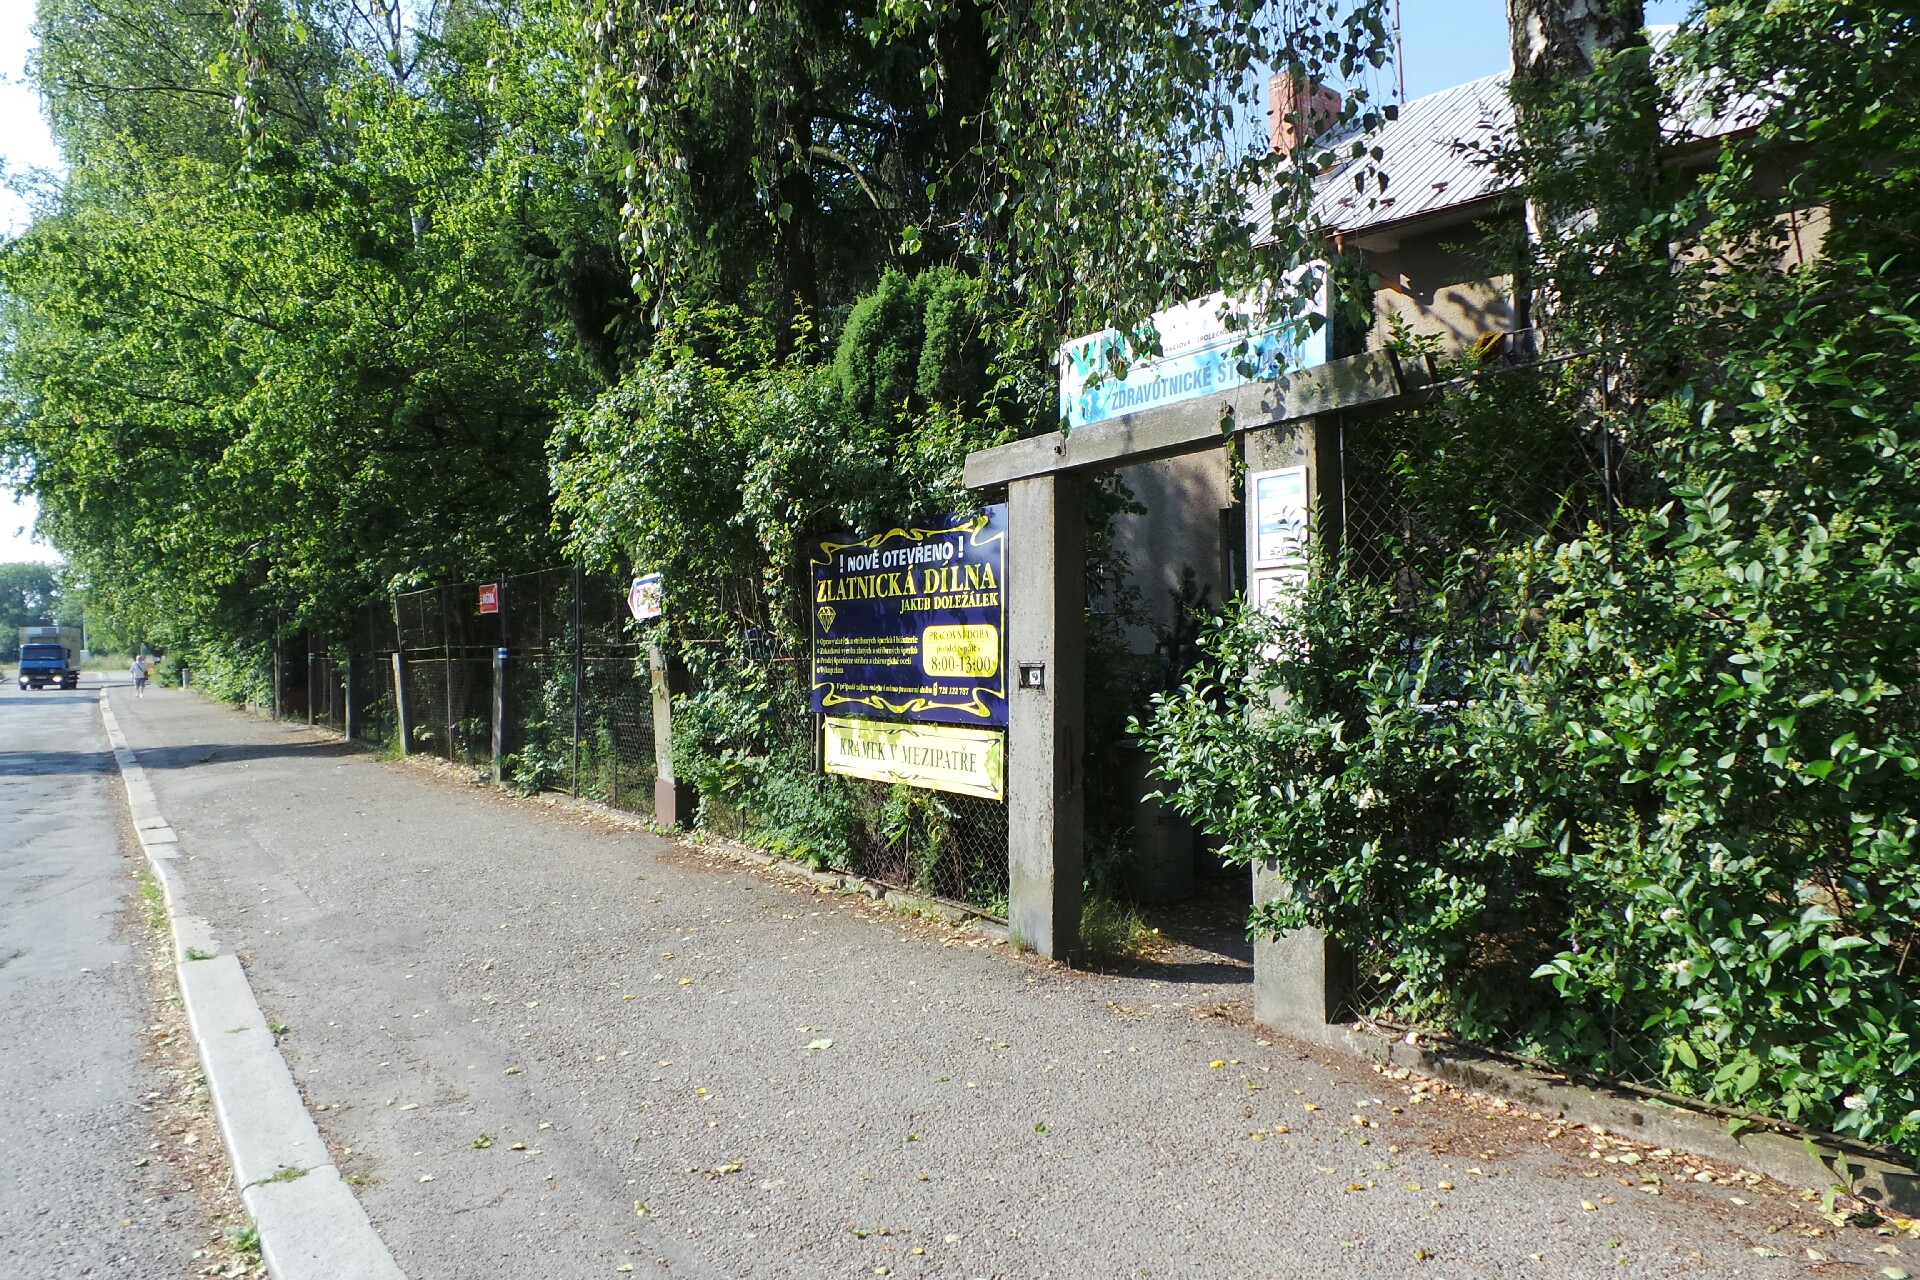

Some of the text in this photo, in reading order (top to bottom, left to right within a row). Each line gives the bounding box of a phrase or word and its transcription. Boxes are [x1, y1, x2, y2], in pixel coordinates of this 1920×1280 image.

[1111, 360, 1212, 411] ZDRAVOTNICKÉ
[839, 535, 964, 574] ! NOVĚ OTEVŘENO !
[816, 560, 998, 603] ZLATNICKÁ DÍLNA
[900, 590, 999, 614] JAKUB DOLEŽÁLEK
[931, 656, 991, 674] 8:00-13:00
[839, 735, 977, 773] KRÁMEK V MEZIPATŘE
